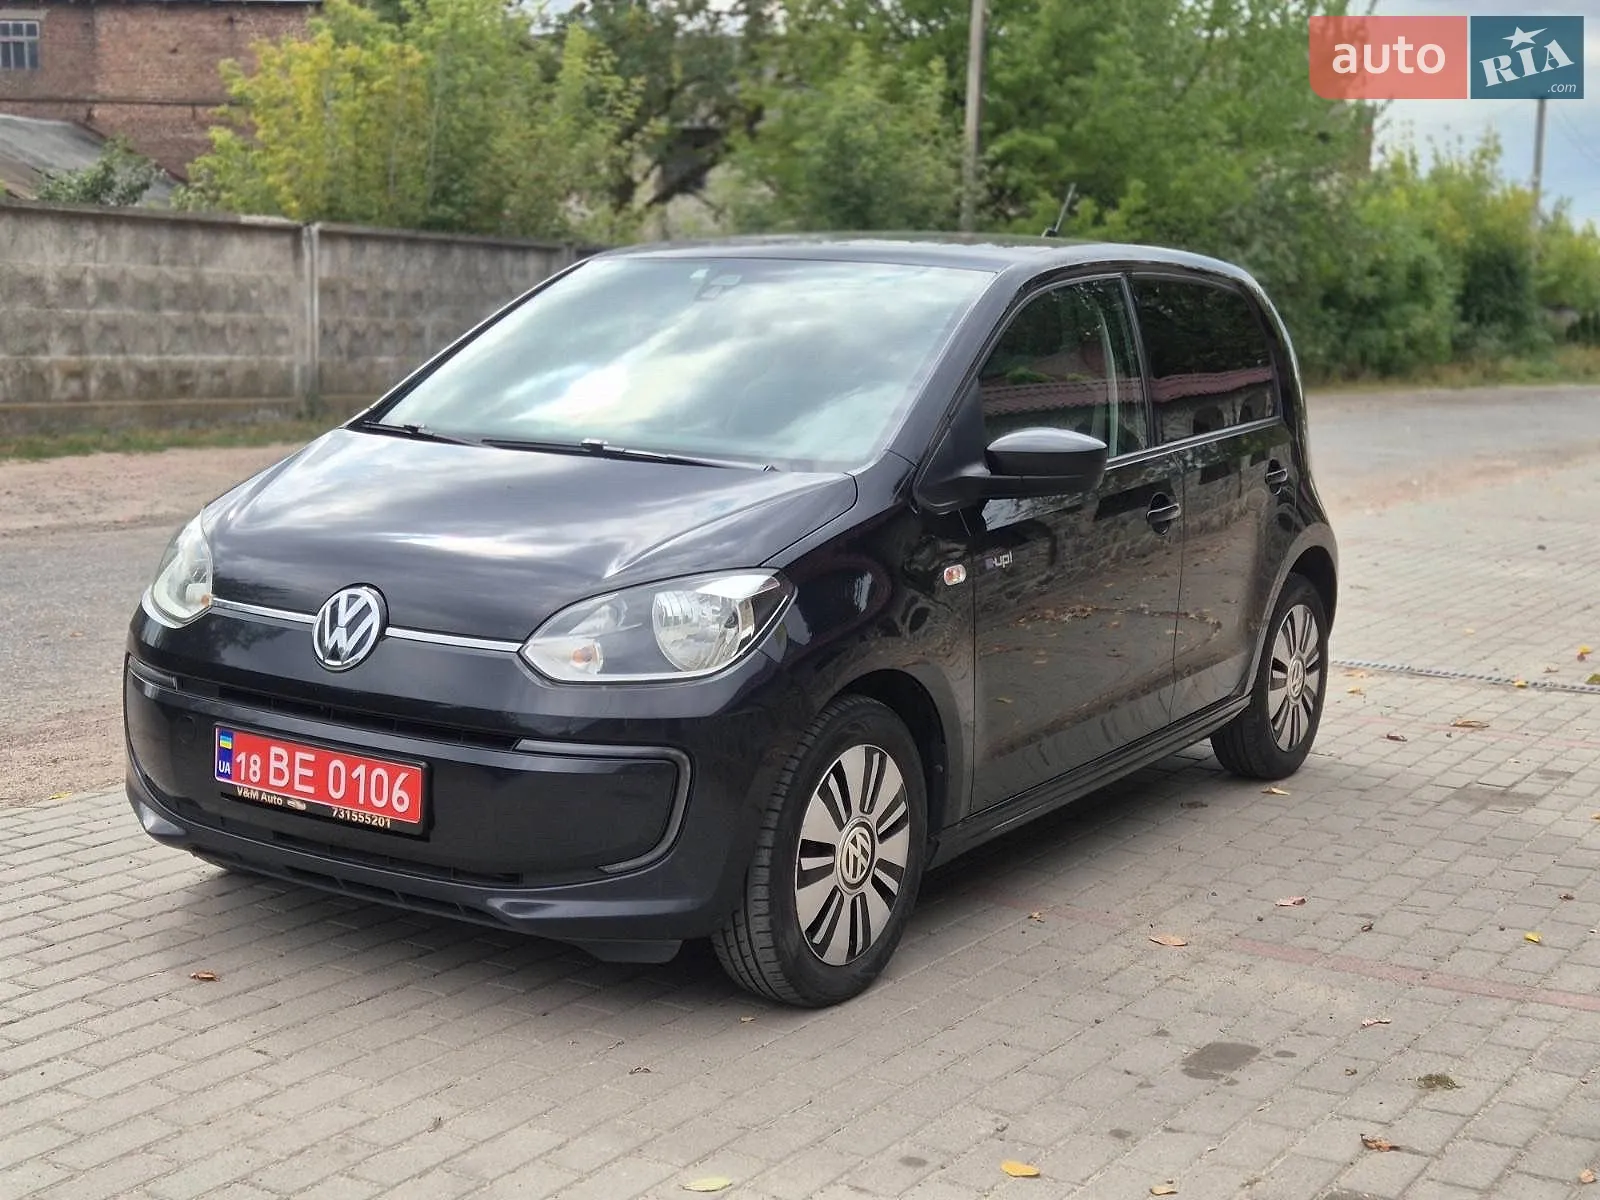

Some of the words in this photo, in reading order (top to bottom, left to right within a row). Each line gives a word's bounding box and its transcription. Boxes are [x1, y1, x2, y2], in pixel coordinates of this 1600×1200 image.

[314, 587, 381, 666] VW
[218, 760, 231, 775] UA
[235, 751, 262, 783] 18
[268, 746, 317, 793] BE
[328, 759, 411, 813] 0106
[236, 786, 259, 800] V&M
[261, 792, 283, 805] Auto
[332, 807, 391, 829] 731555201
